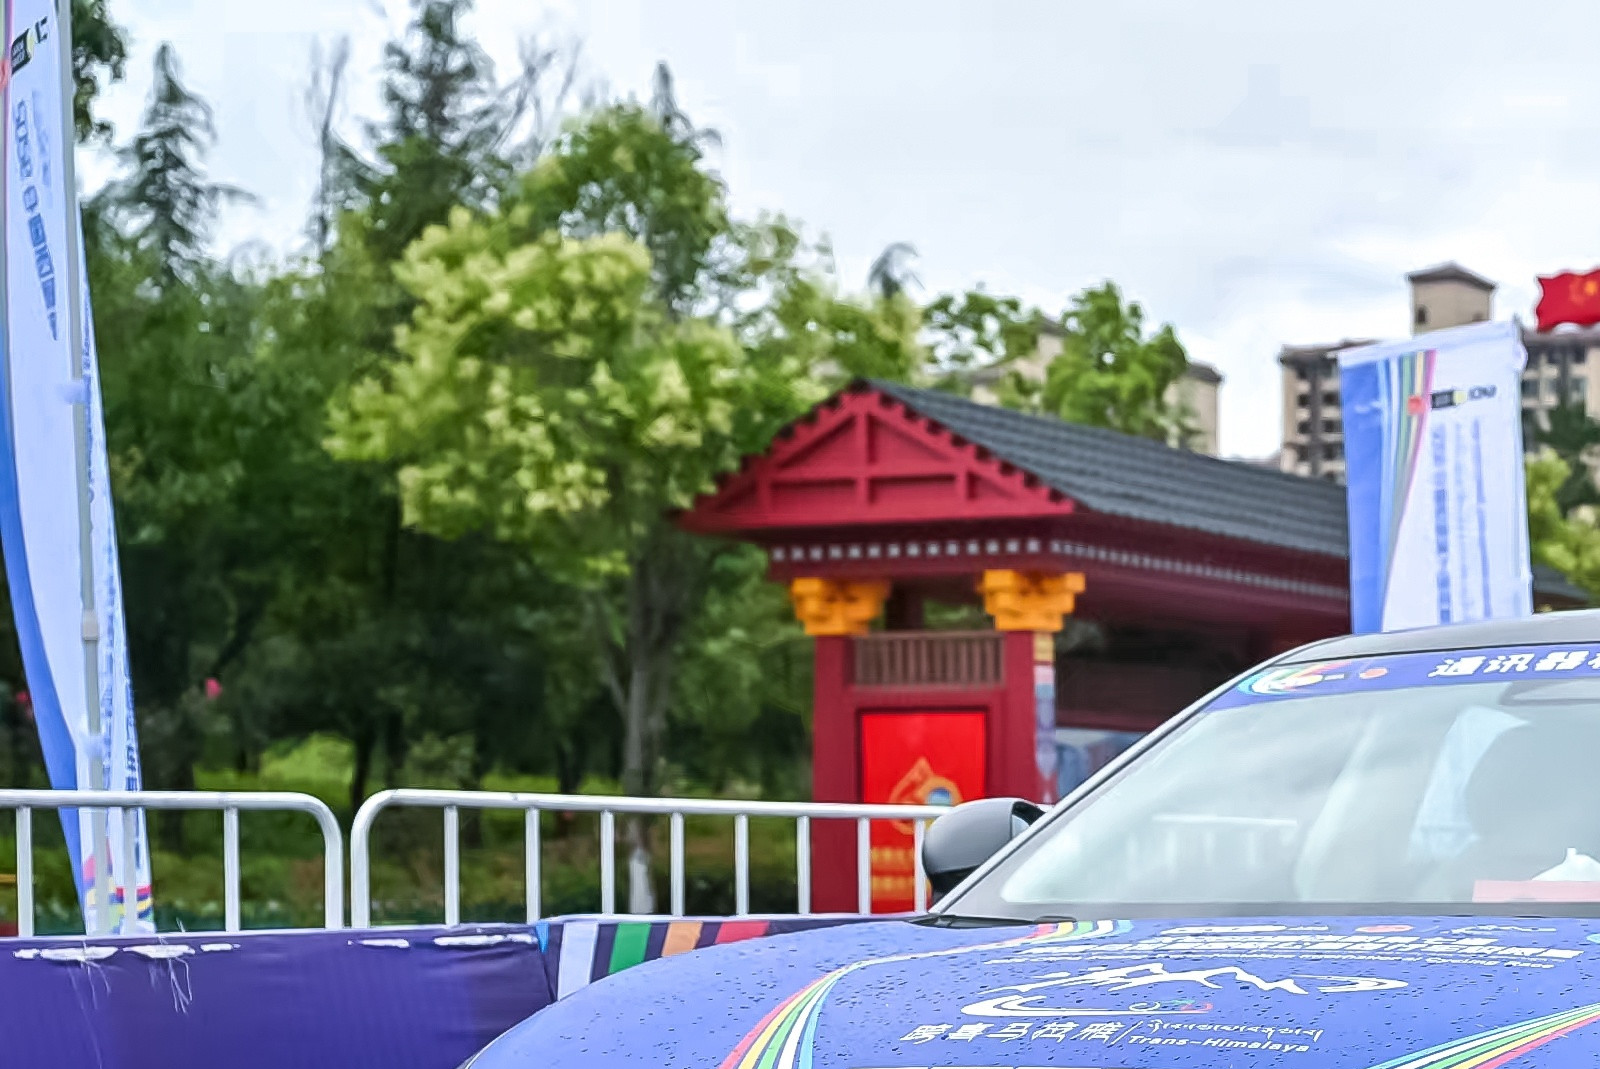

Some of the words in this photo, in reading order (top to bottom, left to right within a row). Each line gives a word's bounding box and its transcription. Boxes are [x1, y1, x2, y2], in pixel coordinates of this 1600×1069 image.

[899, 1021, 1127, 1045] 跨喜马拉雅
[1128, 1034, 1311, 1052] Trans-Himalaya
